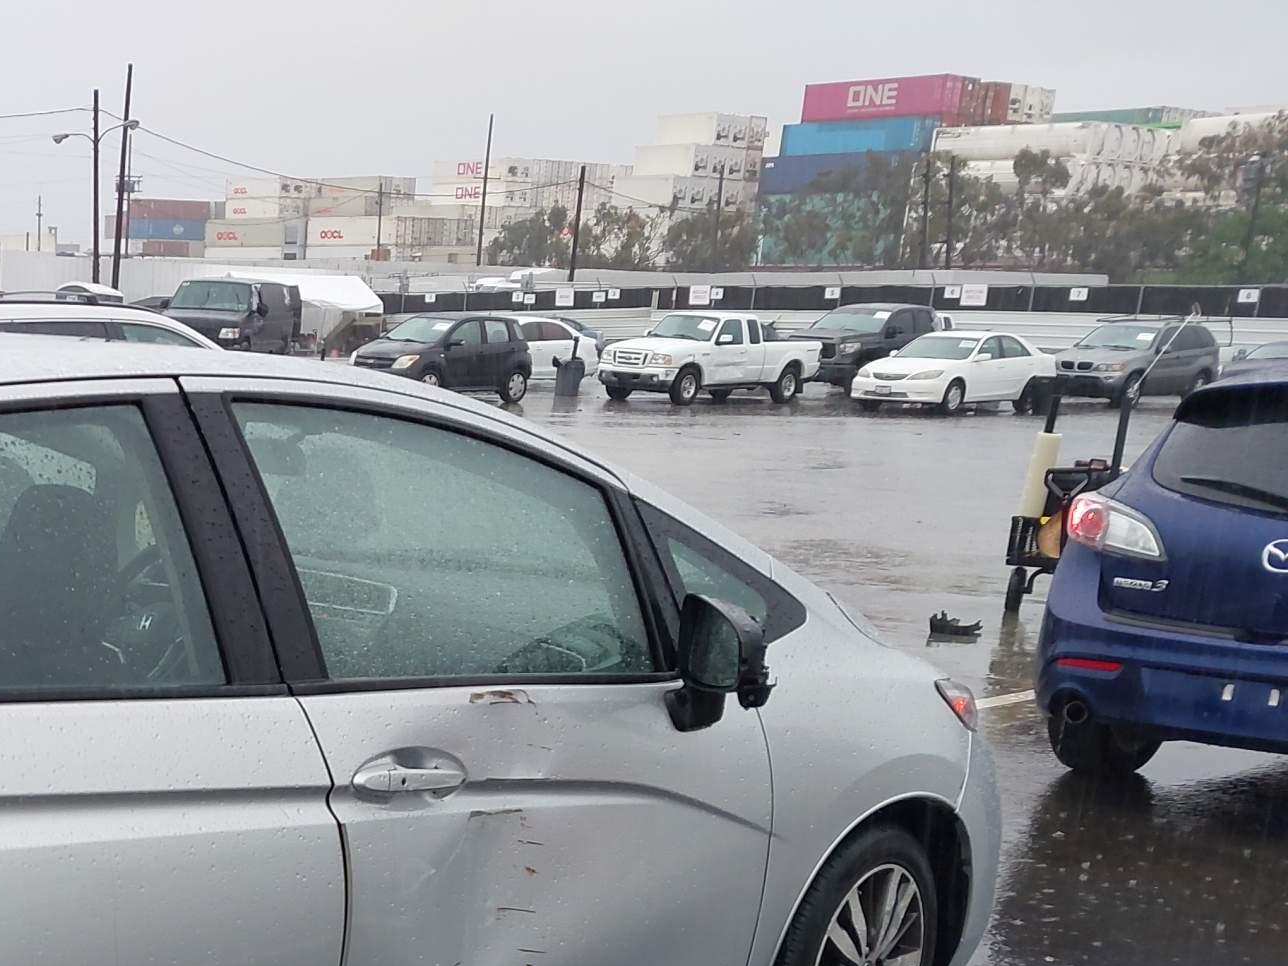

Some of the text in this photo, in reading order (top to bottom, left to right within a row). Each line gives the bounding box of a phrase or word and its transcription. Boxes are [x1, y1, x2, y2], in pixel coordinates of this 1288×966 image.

[847, 83, 899, 107] ONE
[456, 161, 483, 176] ONE
[455, 186, 481, 200] ONE
[319, 230, 344, 239] OOCL
